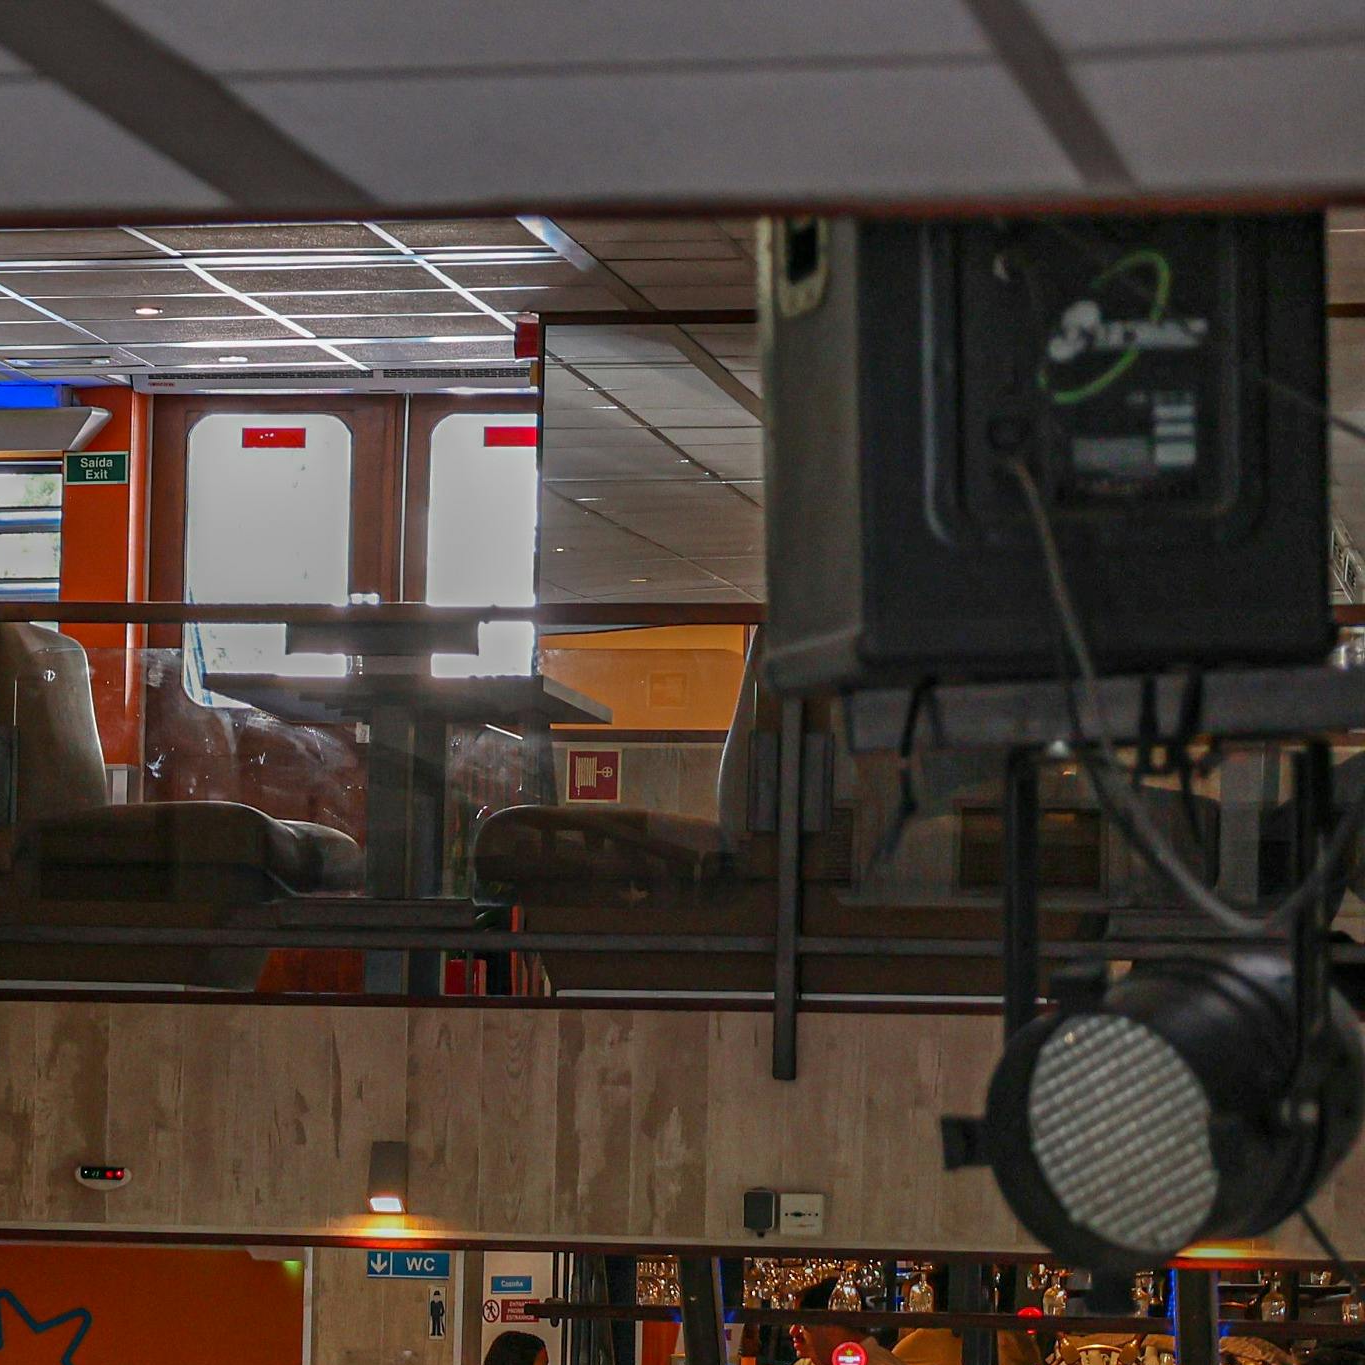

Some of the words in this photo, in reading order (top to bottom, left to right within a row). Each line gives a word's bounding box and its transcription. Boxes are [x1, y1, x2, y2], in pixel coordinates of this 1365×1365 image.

[80, 457, 113, 468] Saída
[85, 469, 109, 480] Exit
[406, 1256, 436, 1272] WC
